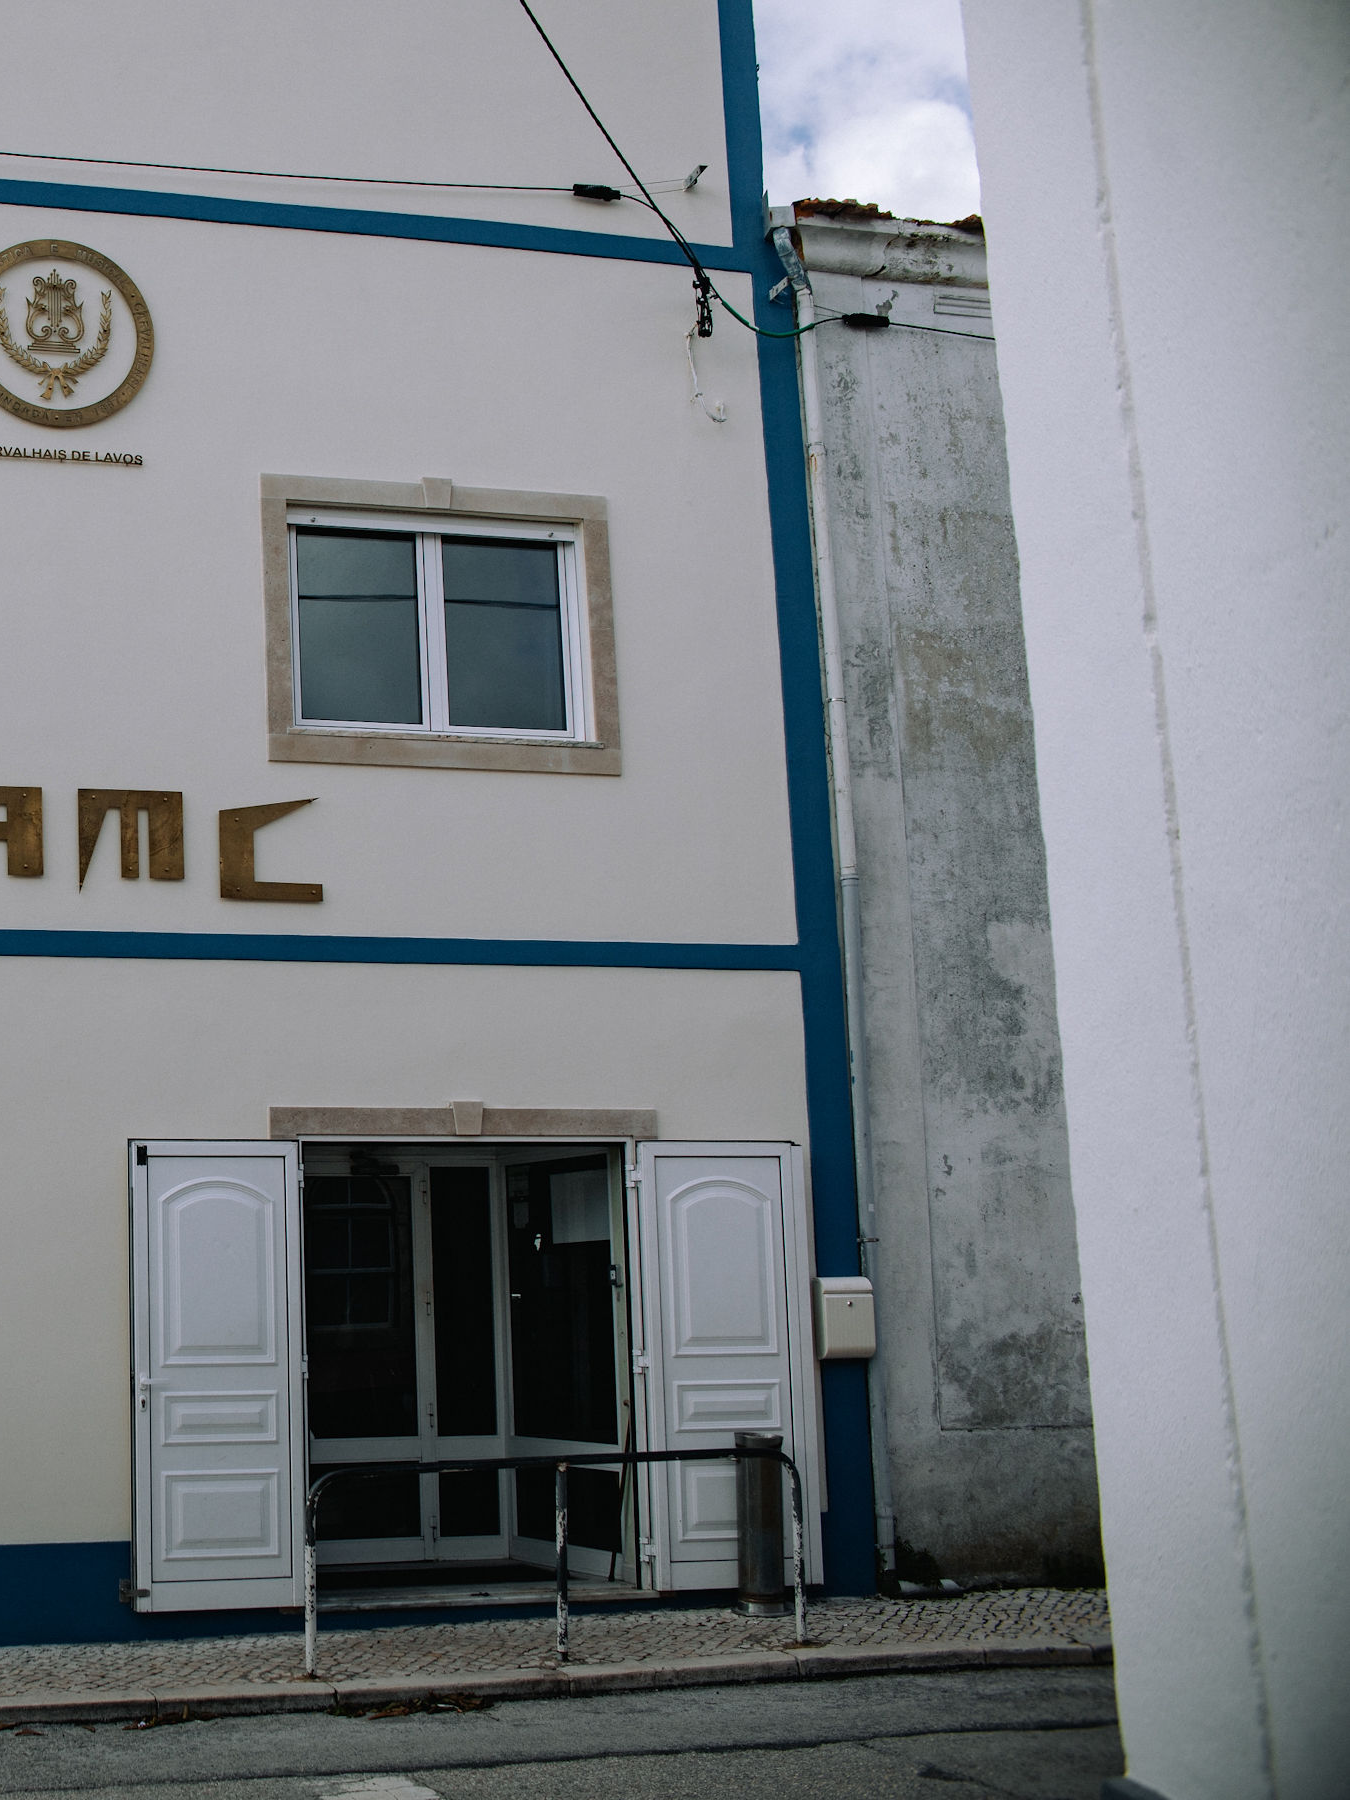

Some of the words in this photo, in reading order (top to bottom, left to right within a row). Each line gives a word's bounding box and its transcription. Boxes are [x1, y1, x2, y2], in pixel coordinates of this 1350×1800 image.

[50, 243, 59, 253] E
[71, 449, 91, 462] DE
[95, 451, 143, 466] LAVOS
